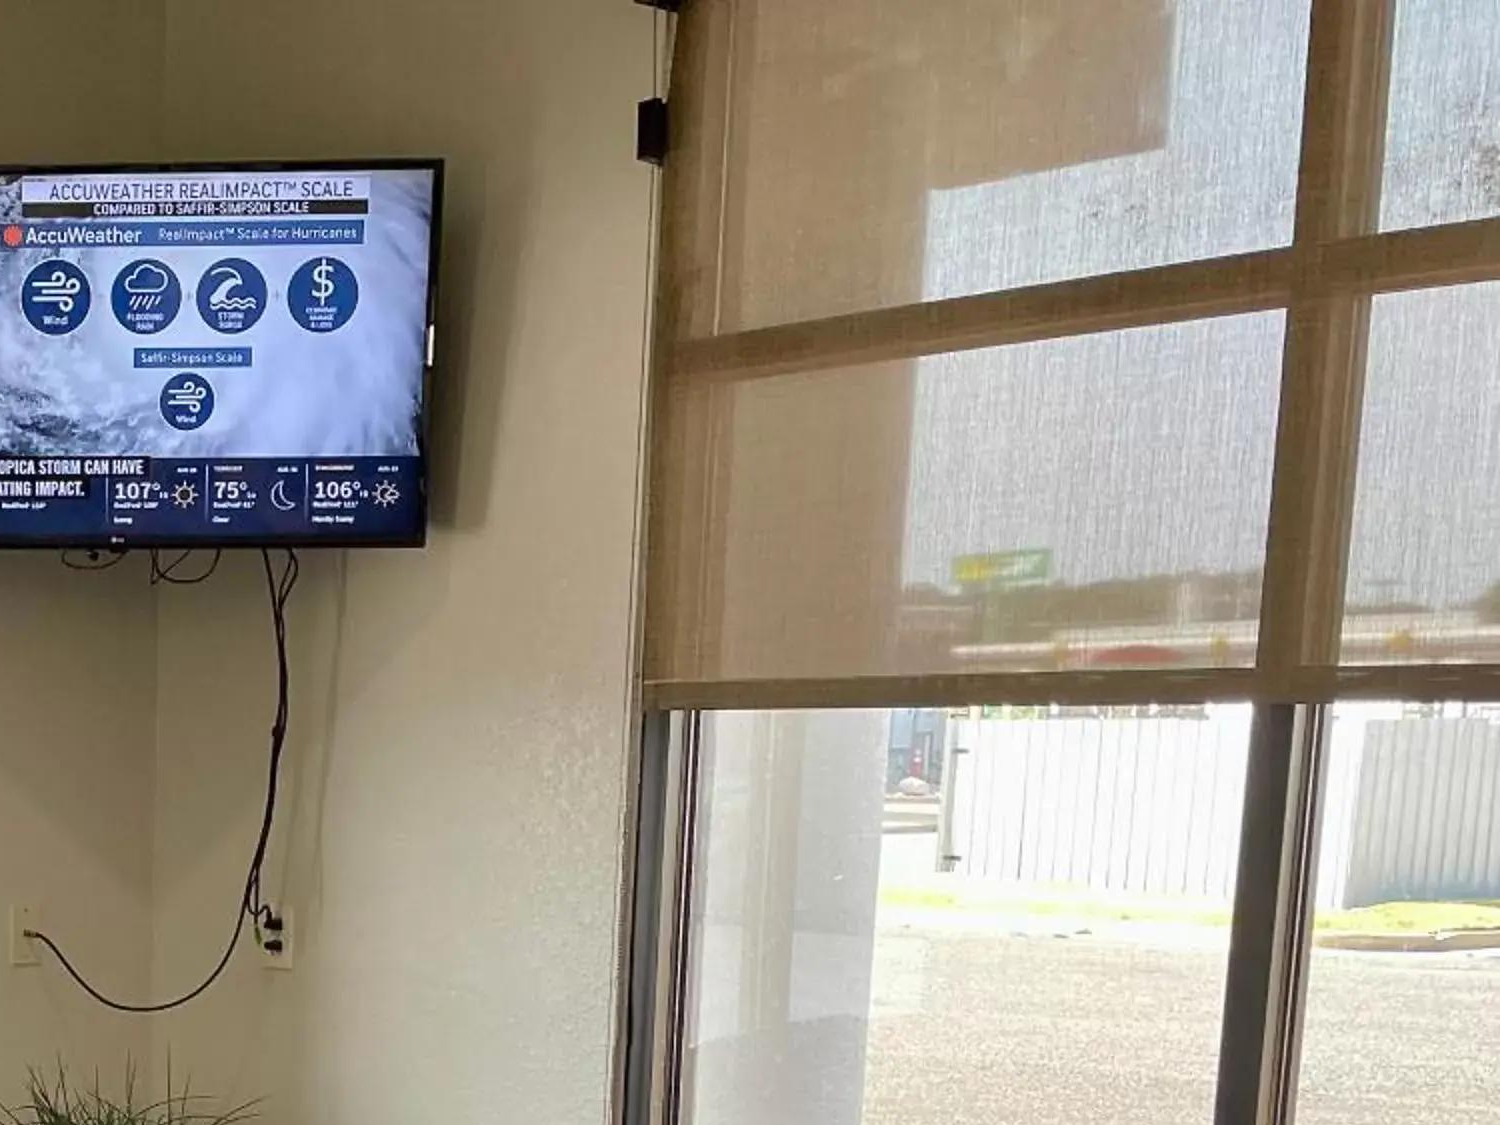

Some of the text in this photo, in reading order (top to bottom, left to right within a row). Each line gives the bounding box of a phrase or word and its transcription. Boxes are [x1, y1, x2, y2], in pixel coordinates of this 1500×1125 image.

[50, 183, 174, 201] ACCUWEATHER
[301, 180, 353, 197] SCALE
[93, 200, 309, 216] COMPARED TO SAFFIR-SIMPSON SCALE
[25, 225, 142, 245] AccuWeather
[237, 226, 269, 241] Scale
[271, 227, 289, 240] for
[291, 226, 357, 240] Hurricanes
[42, 315, 69, 326] Wind
[216, 351, 243, 364] Scale
[39, 459, 81, 475] STORM
[84, 459, 109, 475] CAN
[112, 459, 145, 475] HAVE
[35, 481, 85, 497] IMPACT.
[115, 481, 161, 500] 107°
[214, 481, 248, 500] 75°
[315, 481, 361, 499] 106°
